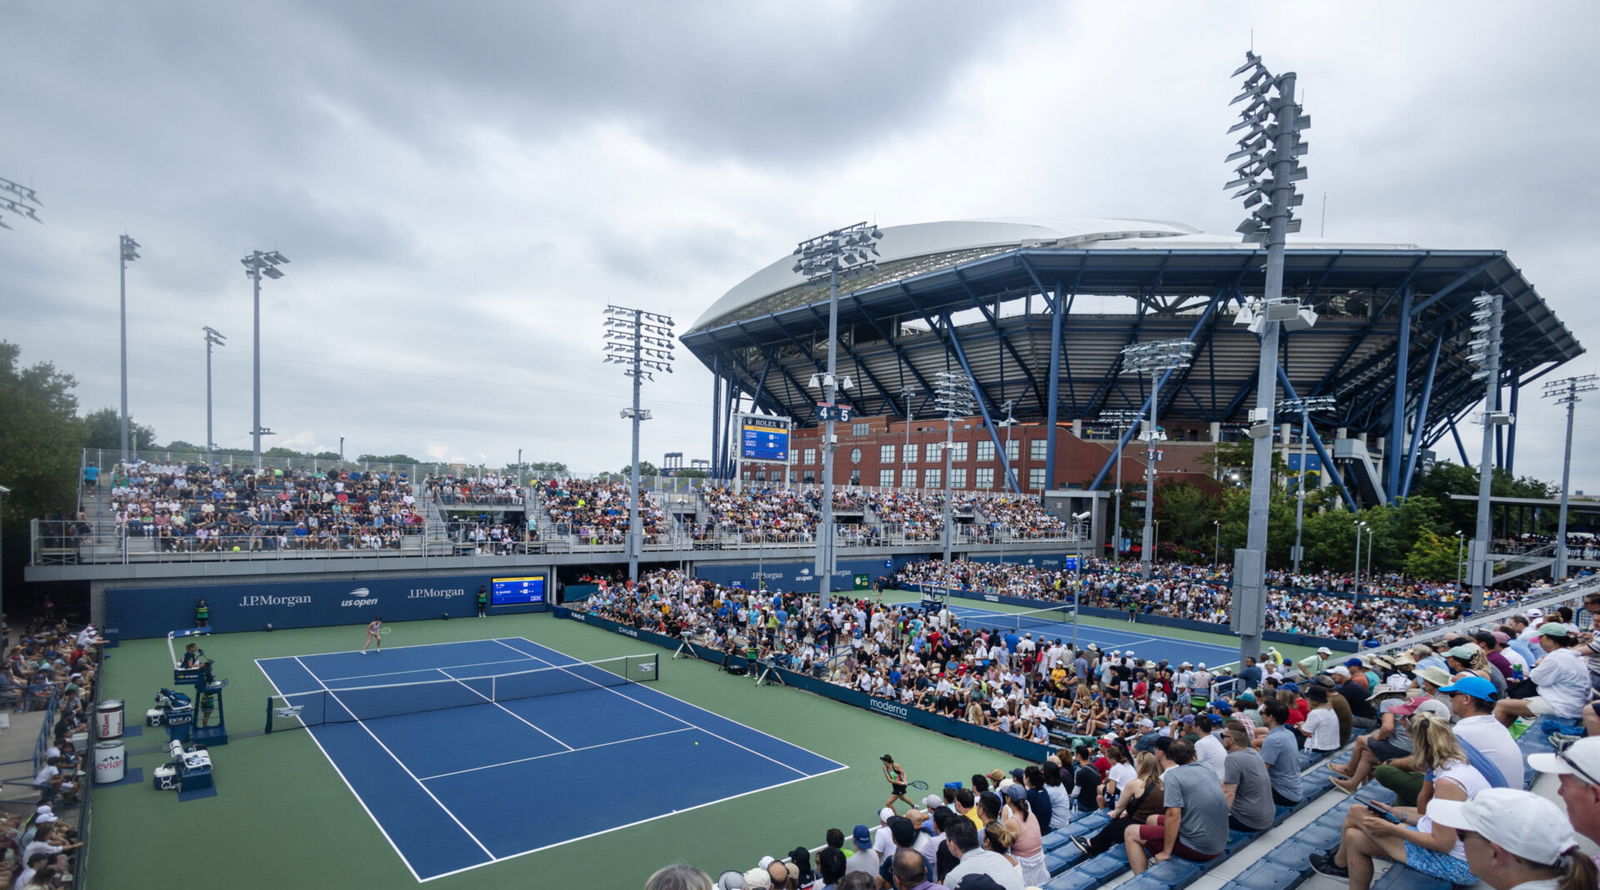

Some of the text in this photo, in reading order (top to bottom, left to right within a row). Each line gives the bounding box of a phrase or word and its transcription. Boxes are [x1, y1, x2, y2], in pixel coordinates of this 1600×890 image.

[820, 407, 828, 419] 4
[841, 410, 849, 422] 5
[755, 419, 777, 427] ROLEX
[407, 588, 464, 599] J.P.Morgan
[239, 595, 311, 607] J.P.Morgan
[354, 598, 378, 608] open
[870, 699, 908, 716] moderna
[102, 714, 110, 737] Wilson
